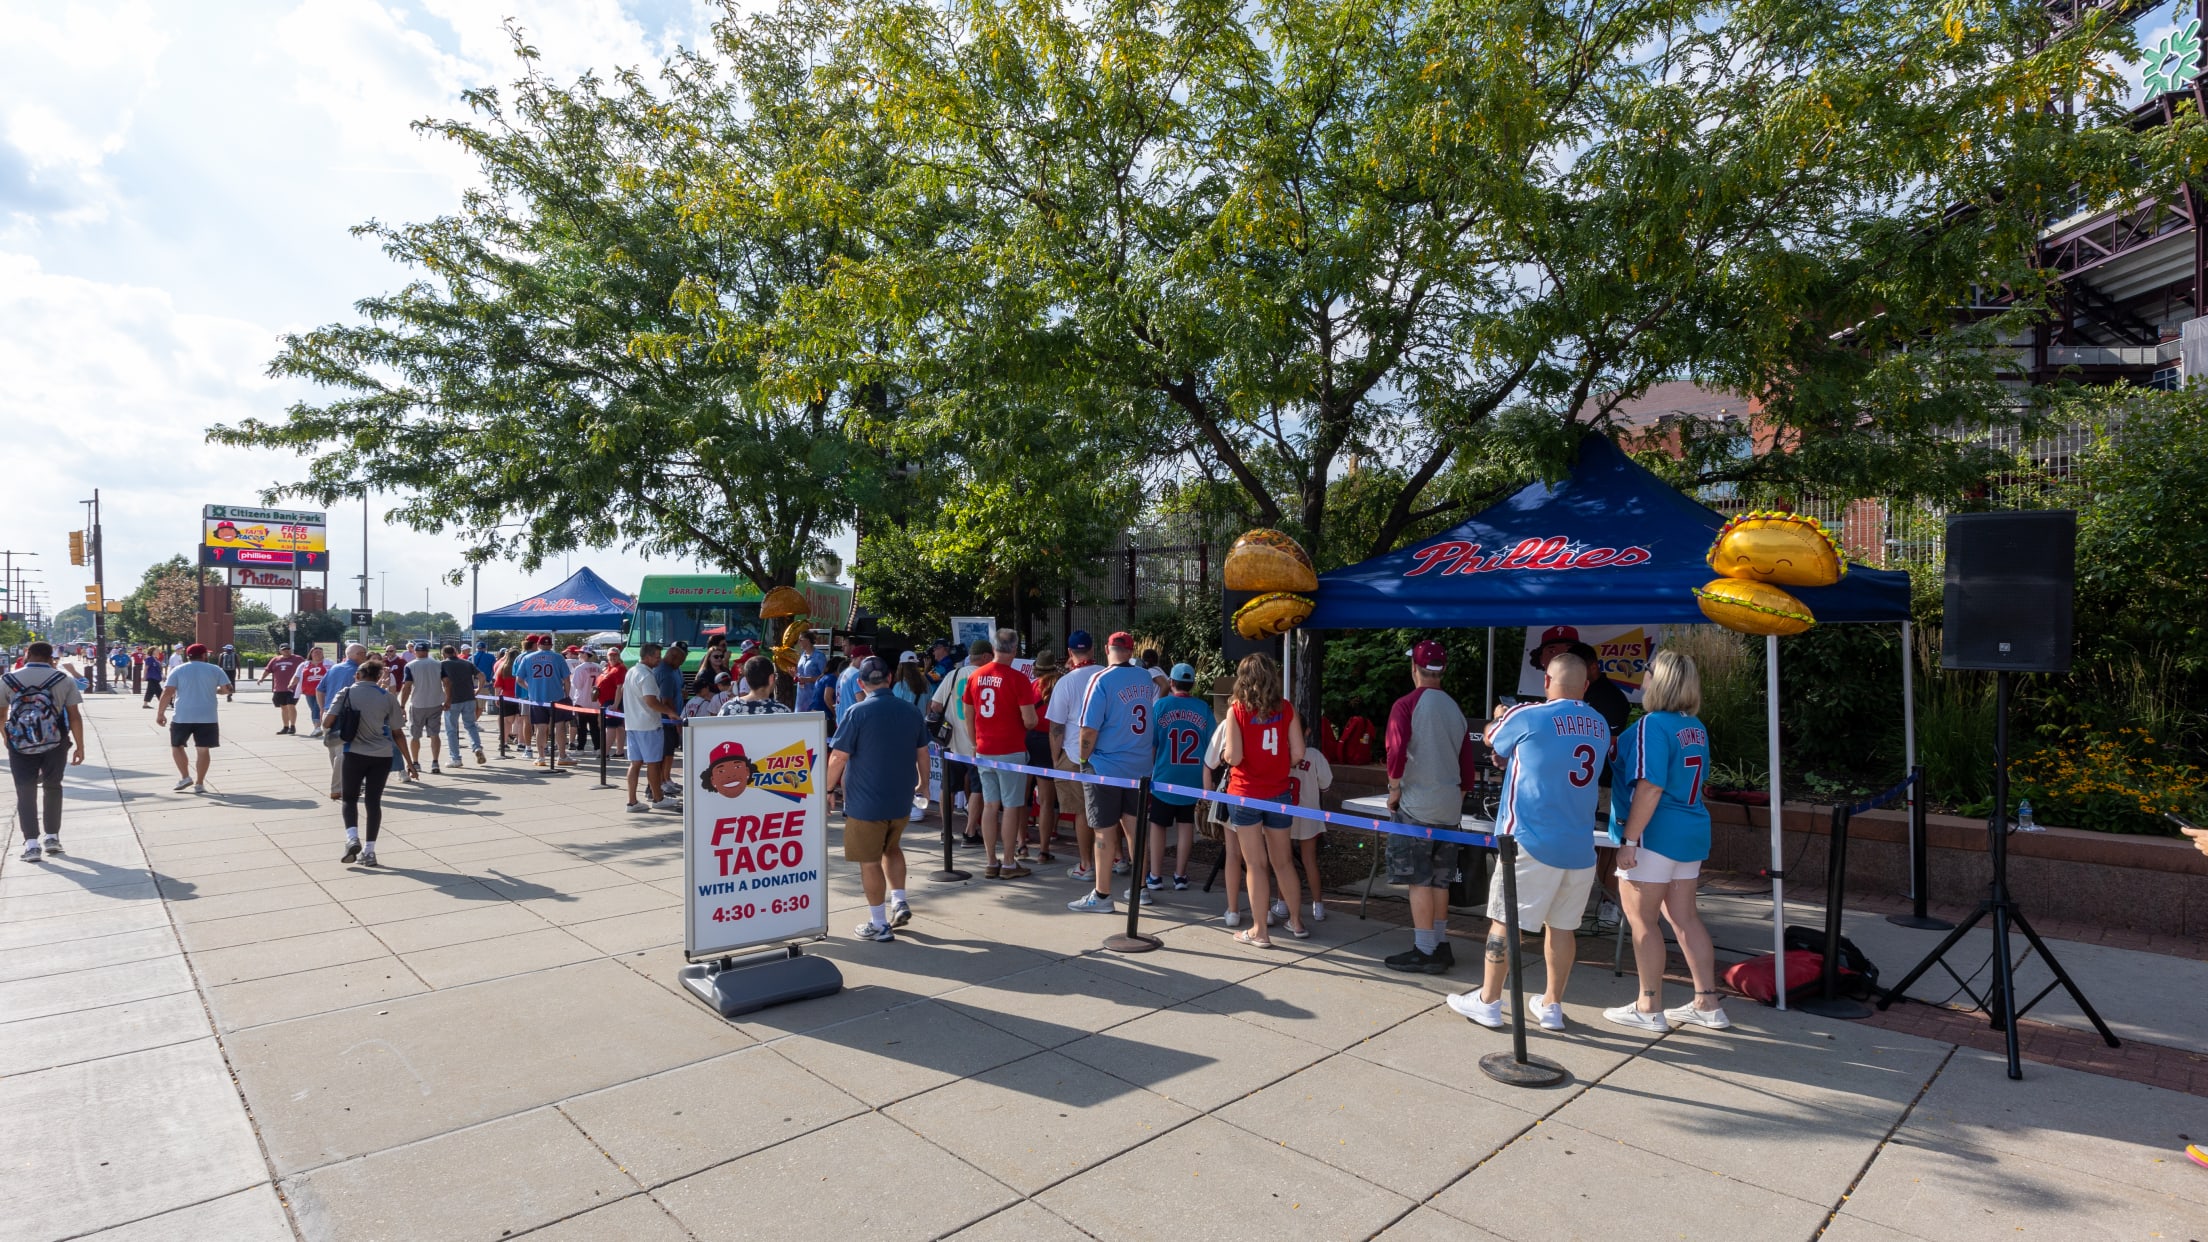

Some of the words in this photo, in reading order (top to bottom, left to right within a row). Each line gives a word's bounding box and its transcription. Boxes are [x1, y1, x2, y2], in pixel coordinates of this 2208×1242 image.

[230, 508, 271, 519] Citizens
[273, 511, 297, 520] Bank
[281, 525, 309, 533] FREE
[282, 532, 307, 540] TACO
[241, 552, 272, 560] phillies
[1403, 535, 1652, 577] Phillies
[238, 568, 293, 586] Phillies
[669, 587, 704, 595] BURRITO
[706, 587, 733, 595] FELI
[519, 598, 598, 612] Phillies
[1600, 643, 1642, 657] TAI'S
[532, 664, 553, 678] 20
[1598, 658, 1644, 673] ACOS
[977, 676, 1003, 688] HARPER
[981, 688, 995, 718] 3
[1131, 704, 1147, 735] 3
[1158, 709, 1207, 729] SCHWARBER
[1553, 714, 1605, 740] HARPER
[1168, 728, 1200, 765] 12
[1262, 727, 1279, 756] 4
[1676, 727, 1706, 749] TURNER
[766, 755, 805, 769] TAI'S
[1569, 744, 1596, 788] 3
[753, 770, 808, 787] TACOS
[1684, 755, 1702, 805] 7
[710, 810, 806, 846] FREE
[714, 840, 804, 877] TACO
[698, 881, 735, 897] WITH
[738, 880, 748, 891] A
[752, 869, 817, 890] DONATION
[712, 903, 756, 923] 4:30
[771, 894, 810, 914] 6:30
